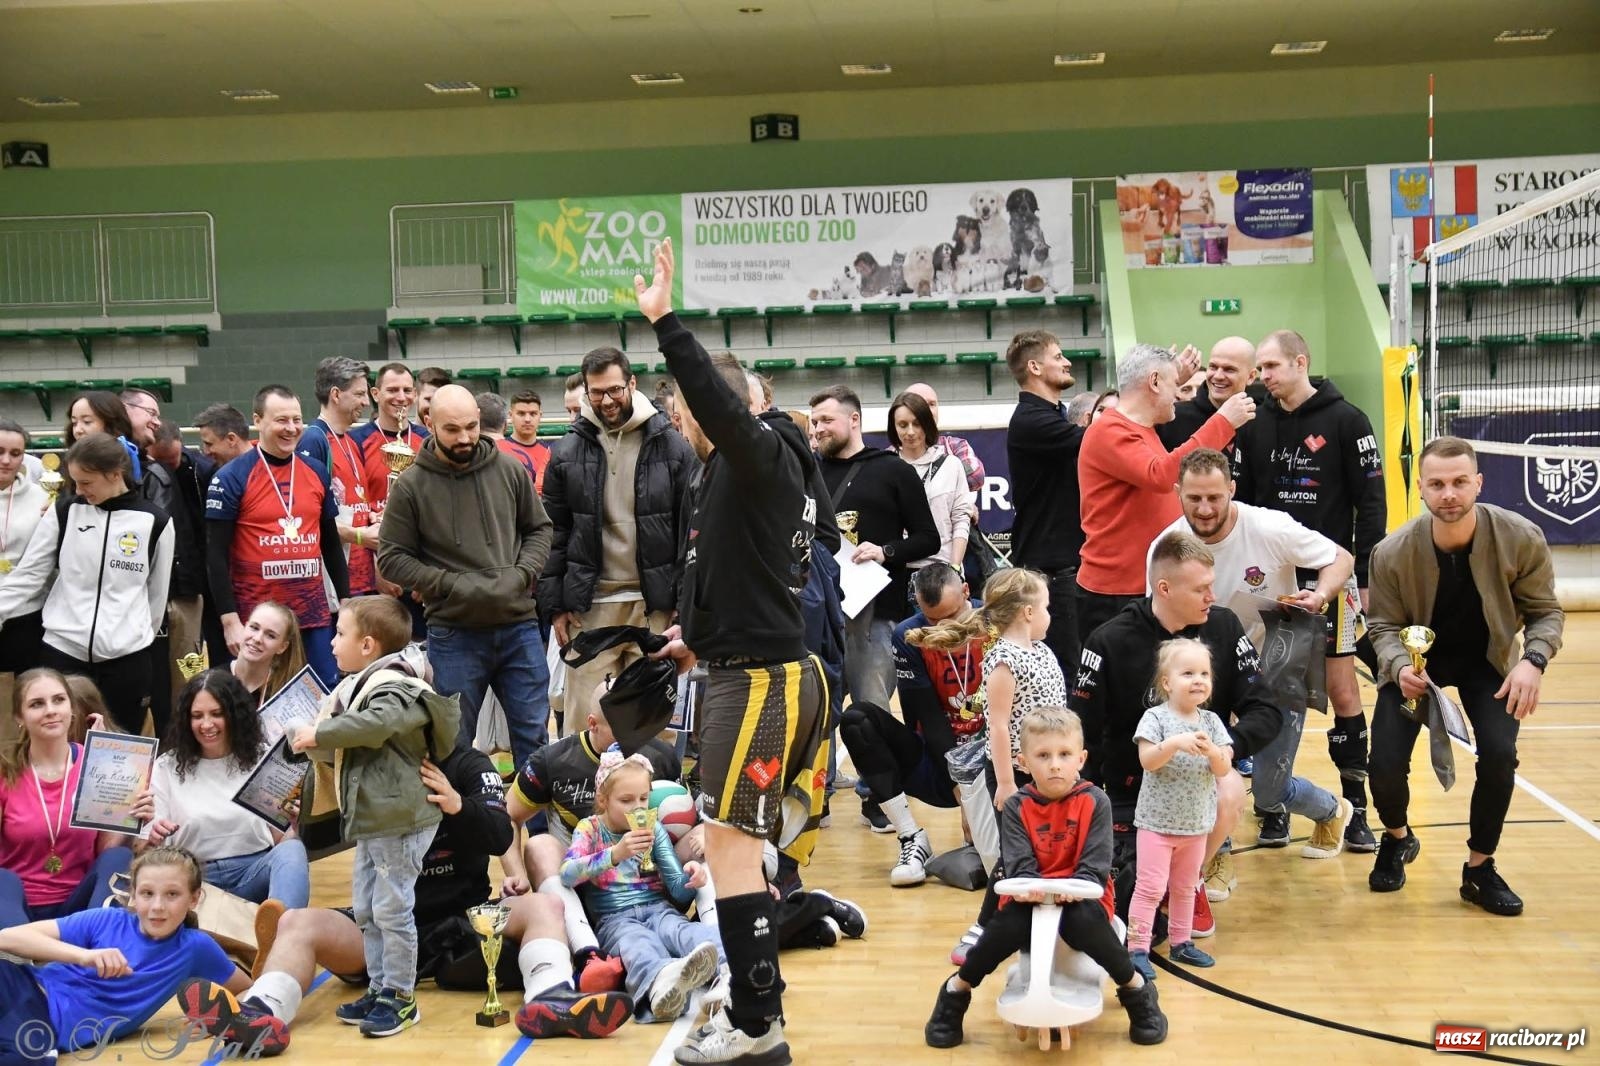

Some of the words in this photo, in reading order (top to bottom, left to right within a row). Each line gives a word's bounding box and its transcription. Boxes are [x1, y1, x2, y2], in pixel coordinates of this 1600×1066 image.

[755, 123, 768, 139] B
[778, 122, 793, 137] B
[20, 150, 44, 165] A
[1494, 168, 1600, 192] STARO
[1243, 181, 1305, 195] Flexadin
[694, 194, 794, 219] WSZYSTKO
[801, 193, 836, 216] DLA
[843, 189, 928, 214] TWOJEGO
[584, 210, 666, 239] ZOO
[695, 220, 810, 246] DOMOWEGO
[817, 218, 856, 242] ZOO
[743, 271, 762, 281] 1989
[259, 533, 318, 547] KATOLIK
[273, 546, 312, 555] GROUP
[110, 559, 144, 573] GROBOSZ
[264, 559, 318, 578] nowiny.pl
[753, 762, 771, 783] Enter
